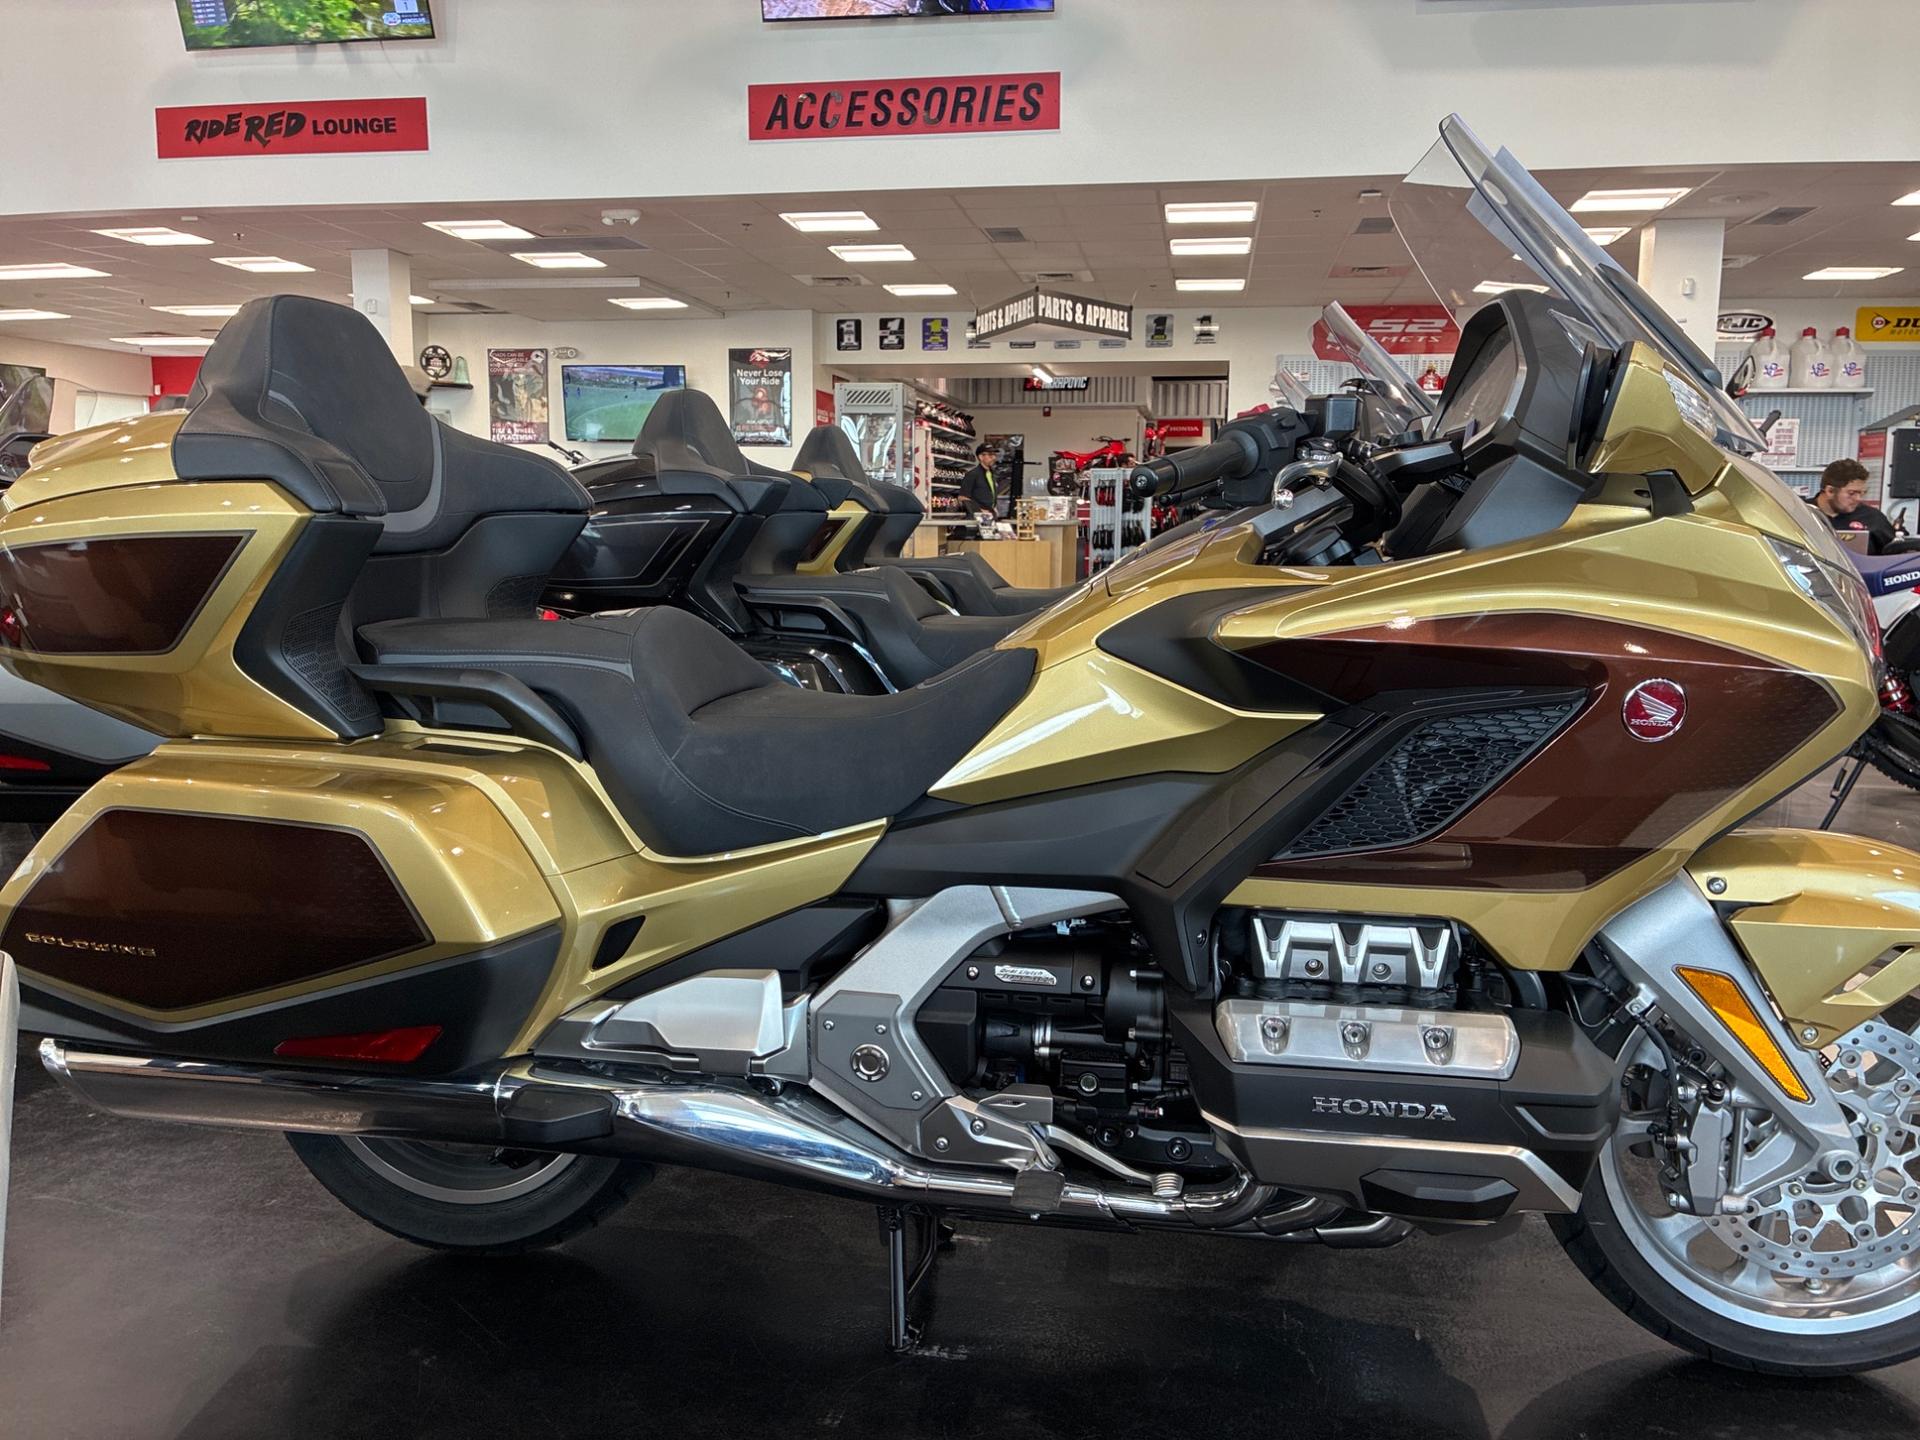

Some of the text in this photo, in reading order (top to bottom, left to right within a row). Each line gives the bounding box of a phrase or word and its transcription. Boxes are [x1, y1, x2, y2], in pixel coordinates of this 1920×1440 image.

[765, 82, 1045, 130] ACCESSORIES
[184, 111, 397, 148] RIDE RED LOUNGE
[976, 296, 1035, 336] PARTS & APPAREL
[1038, 294, 1129, 332] PARTS & APPAREL
[736, 368, 783, 377] Never Lose
[740, 377, 780, 386] Your Ride
[1630, 718, 1674, 728] HONDA
[25, 932, 157, 957] GOLDWING
[1311, 1096, 1457, 1122] HONDA
